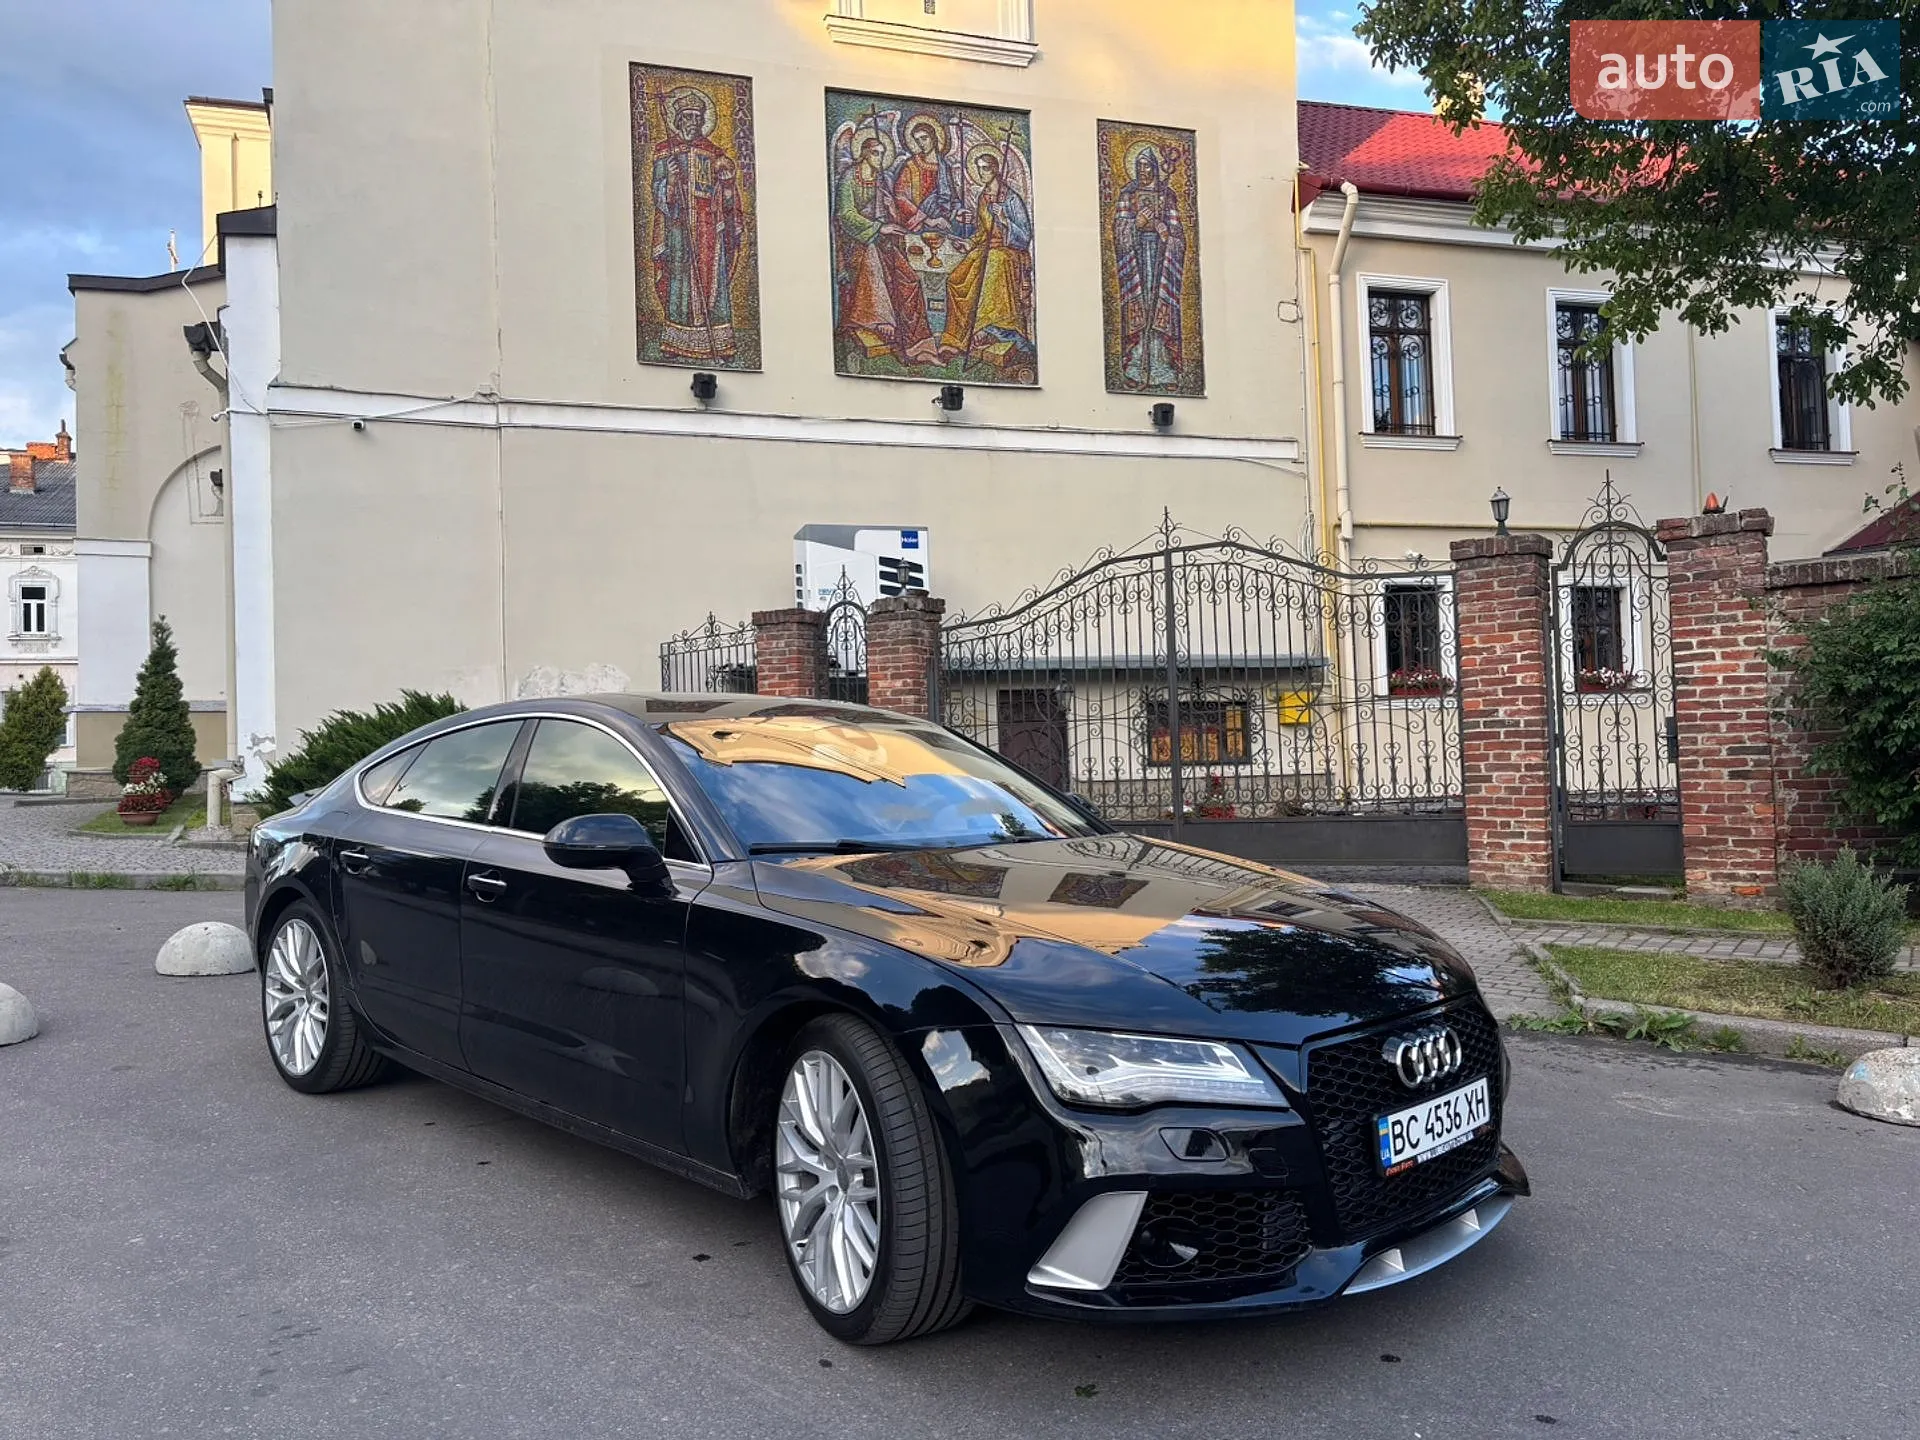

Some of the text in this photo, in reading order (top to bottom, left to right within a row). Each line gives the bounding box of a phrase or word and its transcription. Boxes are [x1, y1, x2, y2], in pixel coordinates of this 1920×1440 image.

[1391, 1114, 1420, 1157] BC
[1425, 1096, 1462, 1142] 4536
[1465, 1083, 1487, 1126] XH
